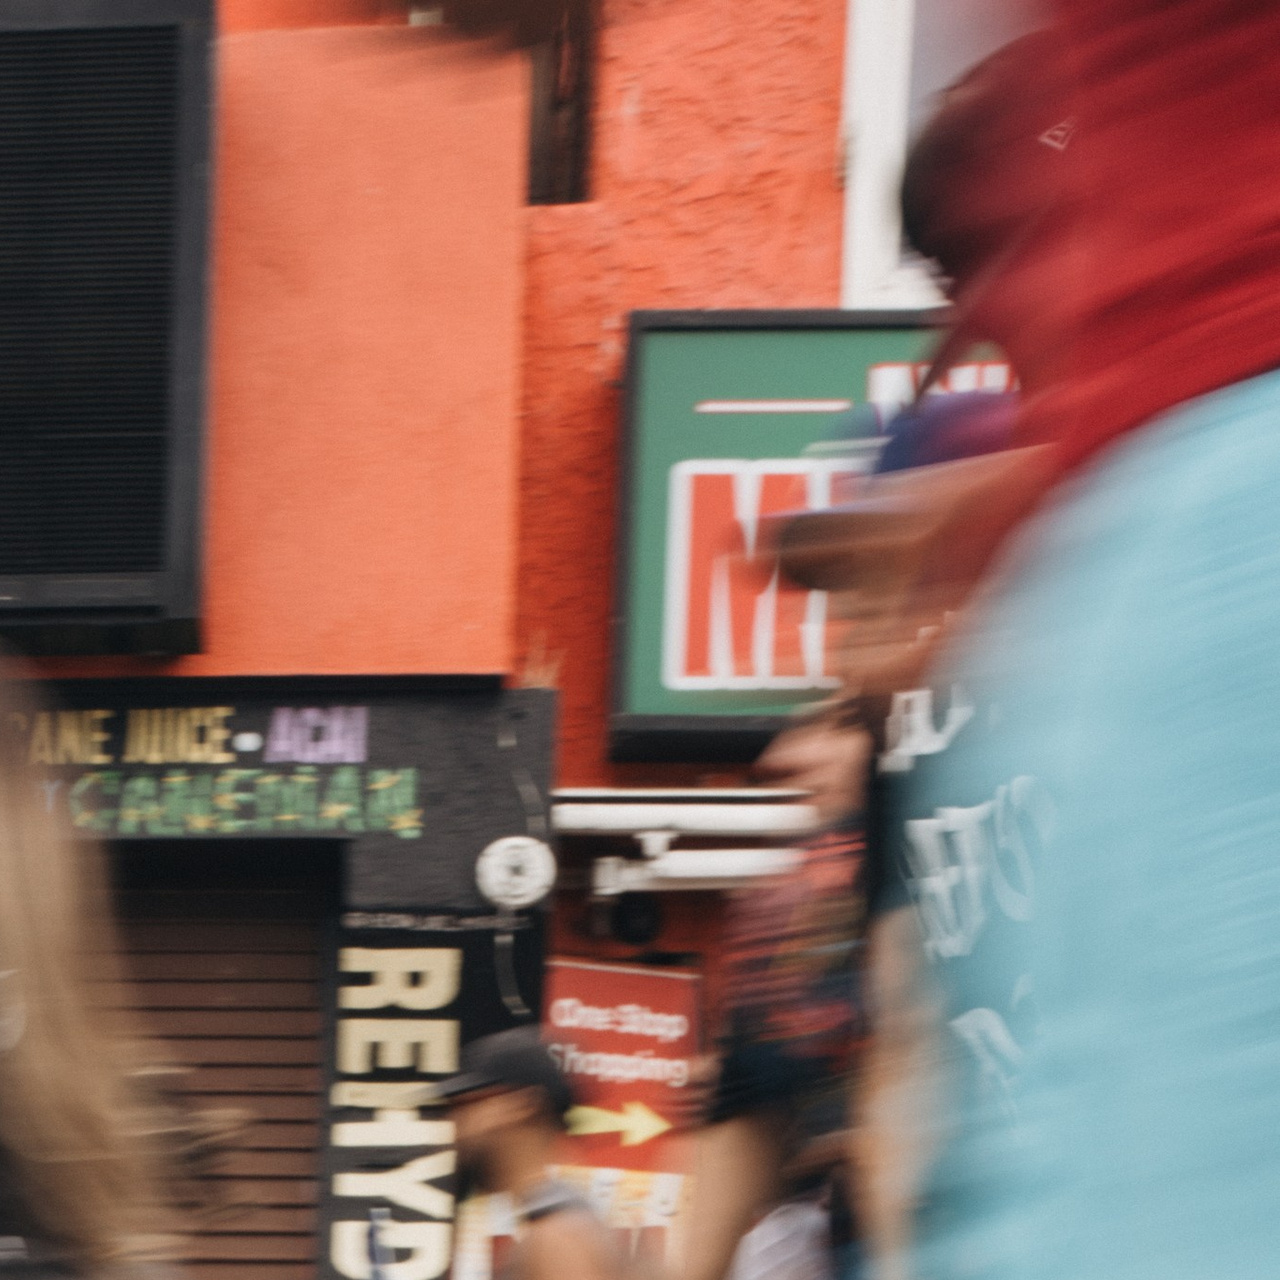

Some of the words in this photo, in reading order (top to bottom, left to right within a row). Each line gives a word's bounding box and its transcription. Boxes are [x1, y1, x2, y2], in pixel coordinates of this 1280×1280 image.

[13, 708, 114, 764] ANE
[123, 705, 235, 763] JUICE
[547, 1042, 690, 1088] Shopping
